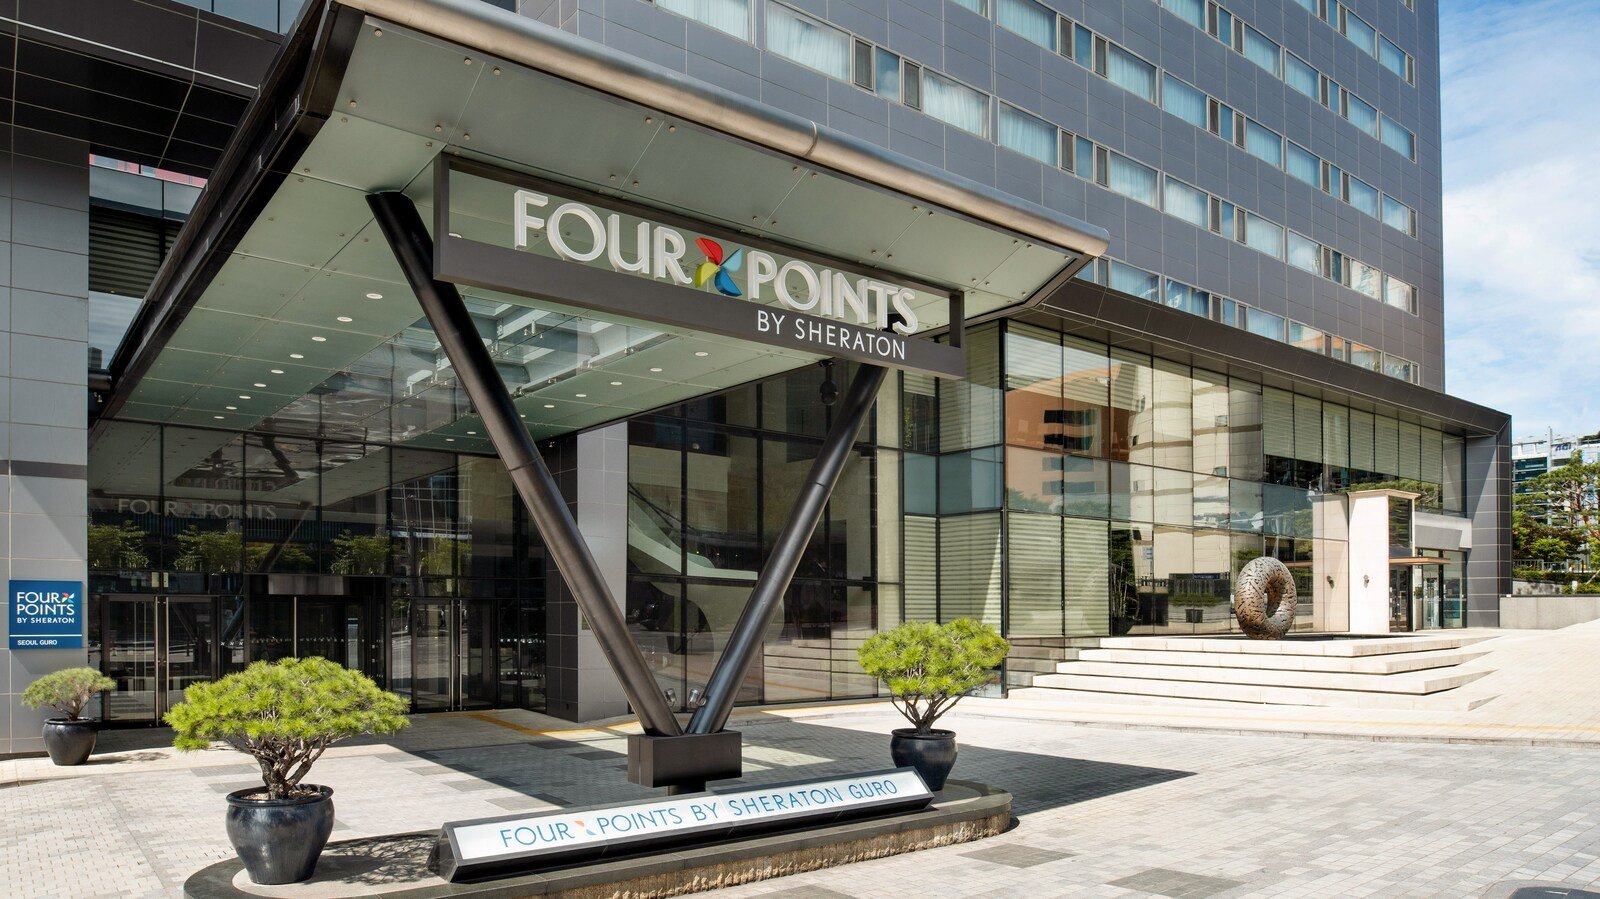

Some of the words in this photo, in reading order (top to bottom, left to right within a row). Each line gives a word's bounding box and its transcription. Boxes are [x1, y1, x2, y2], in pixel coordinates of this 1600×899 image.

[514, 189, 693, 285] FOUR
[747, 250, 918, 335] POINTS
[757, 309, 786, 335] BY
[795, 318, 905, 360] SHERATON
[16, 591, 61, 604] FOUR
[16, 603, 75, 616] POINTS
[499, 822, 575, 848] FOUR
[596, 807, 683, 835] POINTS
[690, 802, 719, 822] BY
[728, 786, 844, 816] SHERATON
[848, 779, 898, 800] GURO
